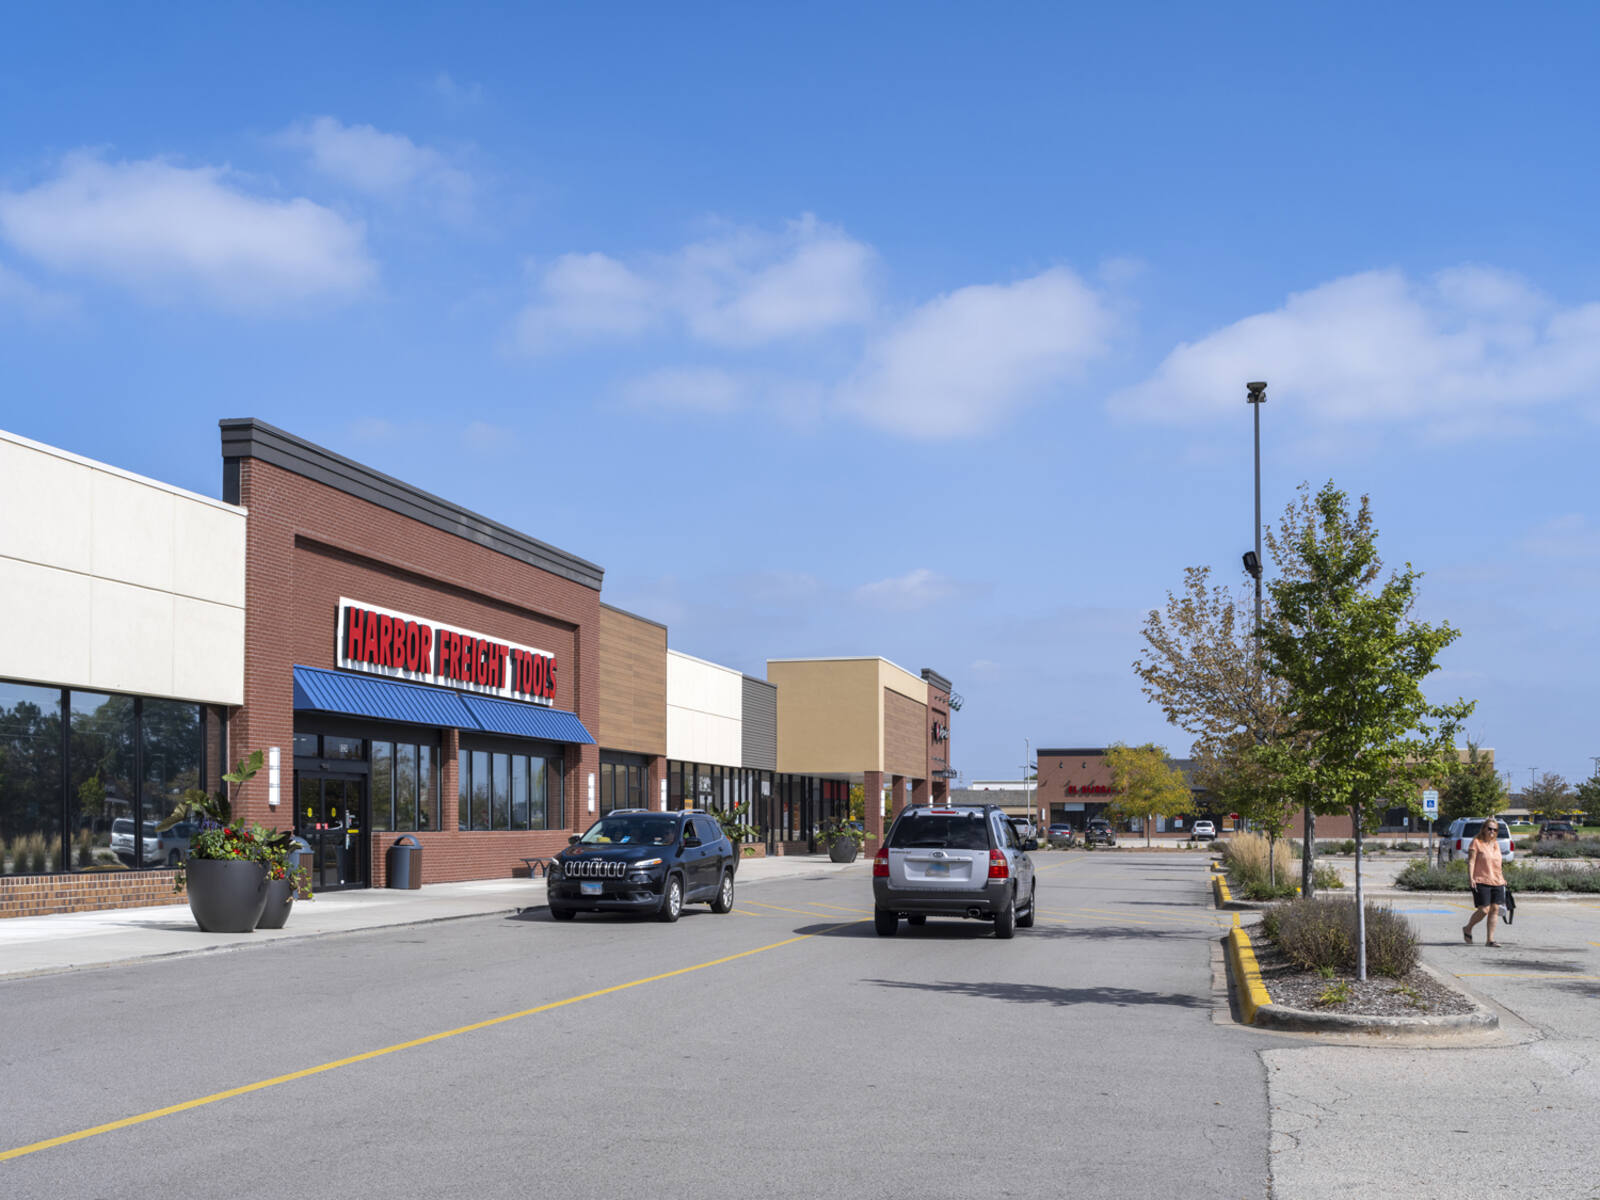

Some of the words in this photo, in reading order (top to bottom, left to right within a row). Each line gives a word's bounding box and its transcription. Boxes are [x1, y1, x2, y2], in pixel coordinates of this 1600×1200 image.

[347, 606, 433, 674] HARBOR
[438, 629, 510, 688] FREIGHT
[512, 648, 558, 699] TOOLS
